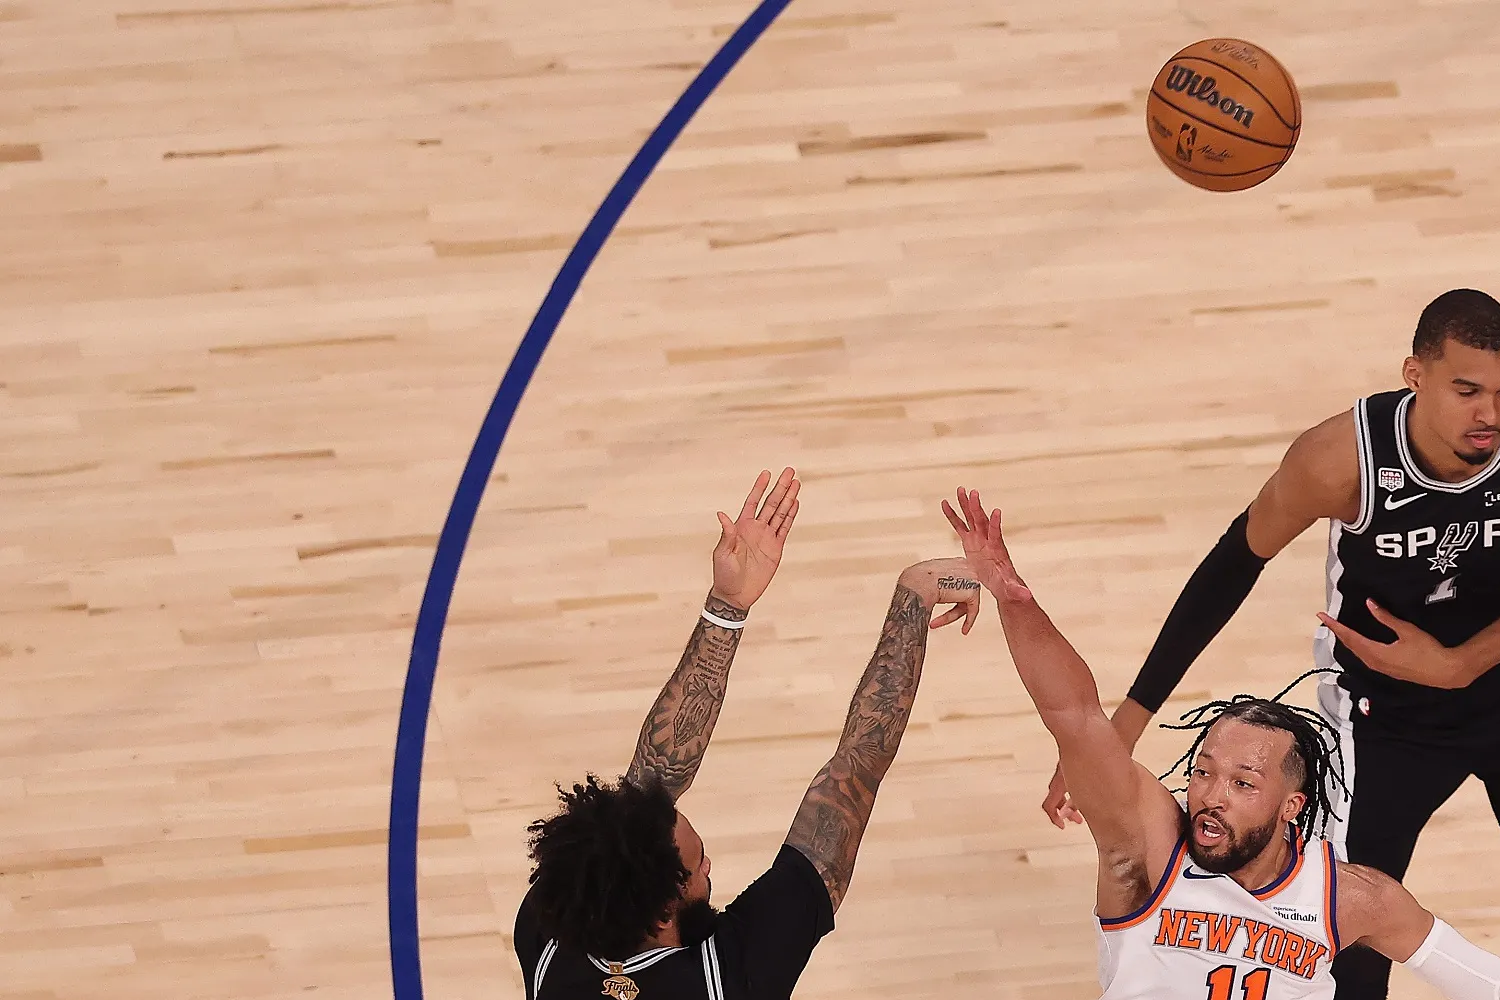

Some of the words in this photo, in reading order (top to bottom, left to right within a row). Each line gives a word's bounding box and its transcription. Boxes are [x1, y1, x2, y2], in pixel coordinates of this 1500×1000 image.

[1166, 65, 1254, 129] Wilson
[1425, 573, 1462, 605] 1
[1290, 912, 1317, 922] dhabi
[1154, 908, 1242, 954] NEW
[1241, 918, 1330, 980] YORK
[602, 980, 640, 994] Finals
